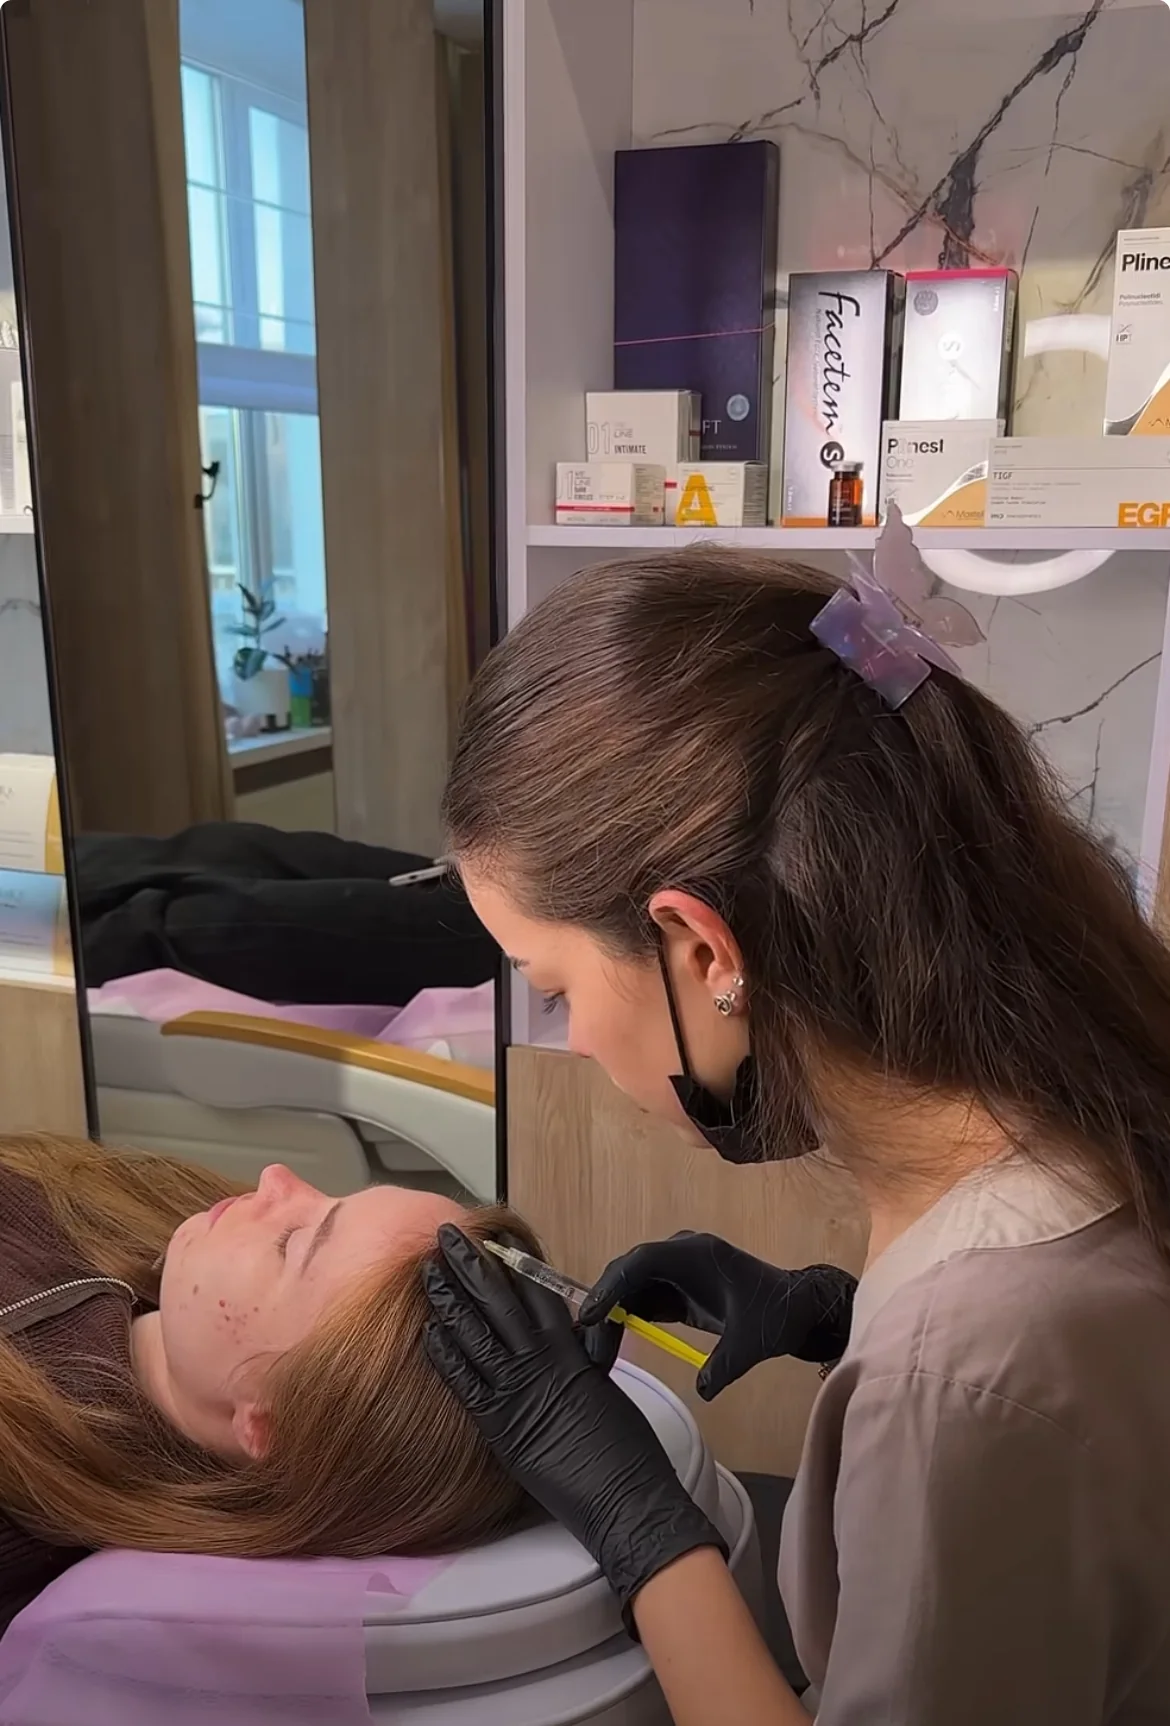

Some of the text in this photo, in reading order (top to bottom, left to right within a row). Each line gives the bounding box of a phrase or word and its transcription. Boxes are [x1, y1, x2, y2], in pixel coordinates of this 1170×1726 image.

[818, 291, 860, 436] Facetem
[614, 444, 648, 455] INTIMATE
[675, 472, 719, 527] A
